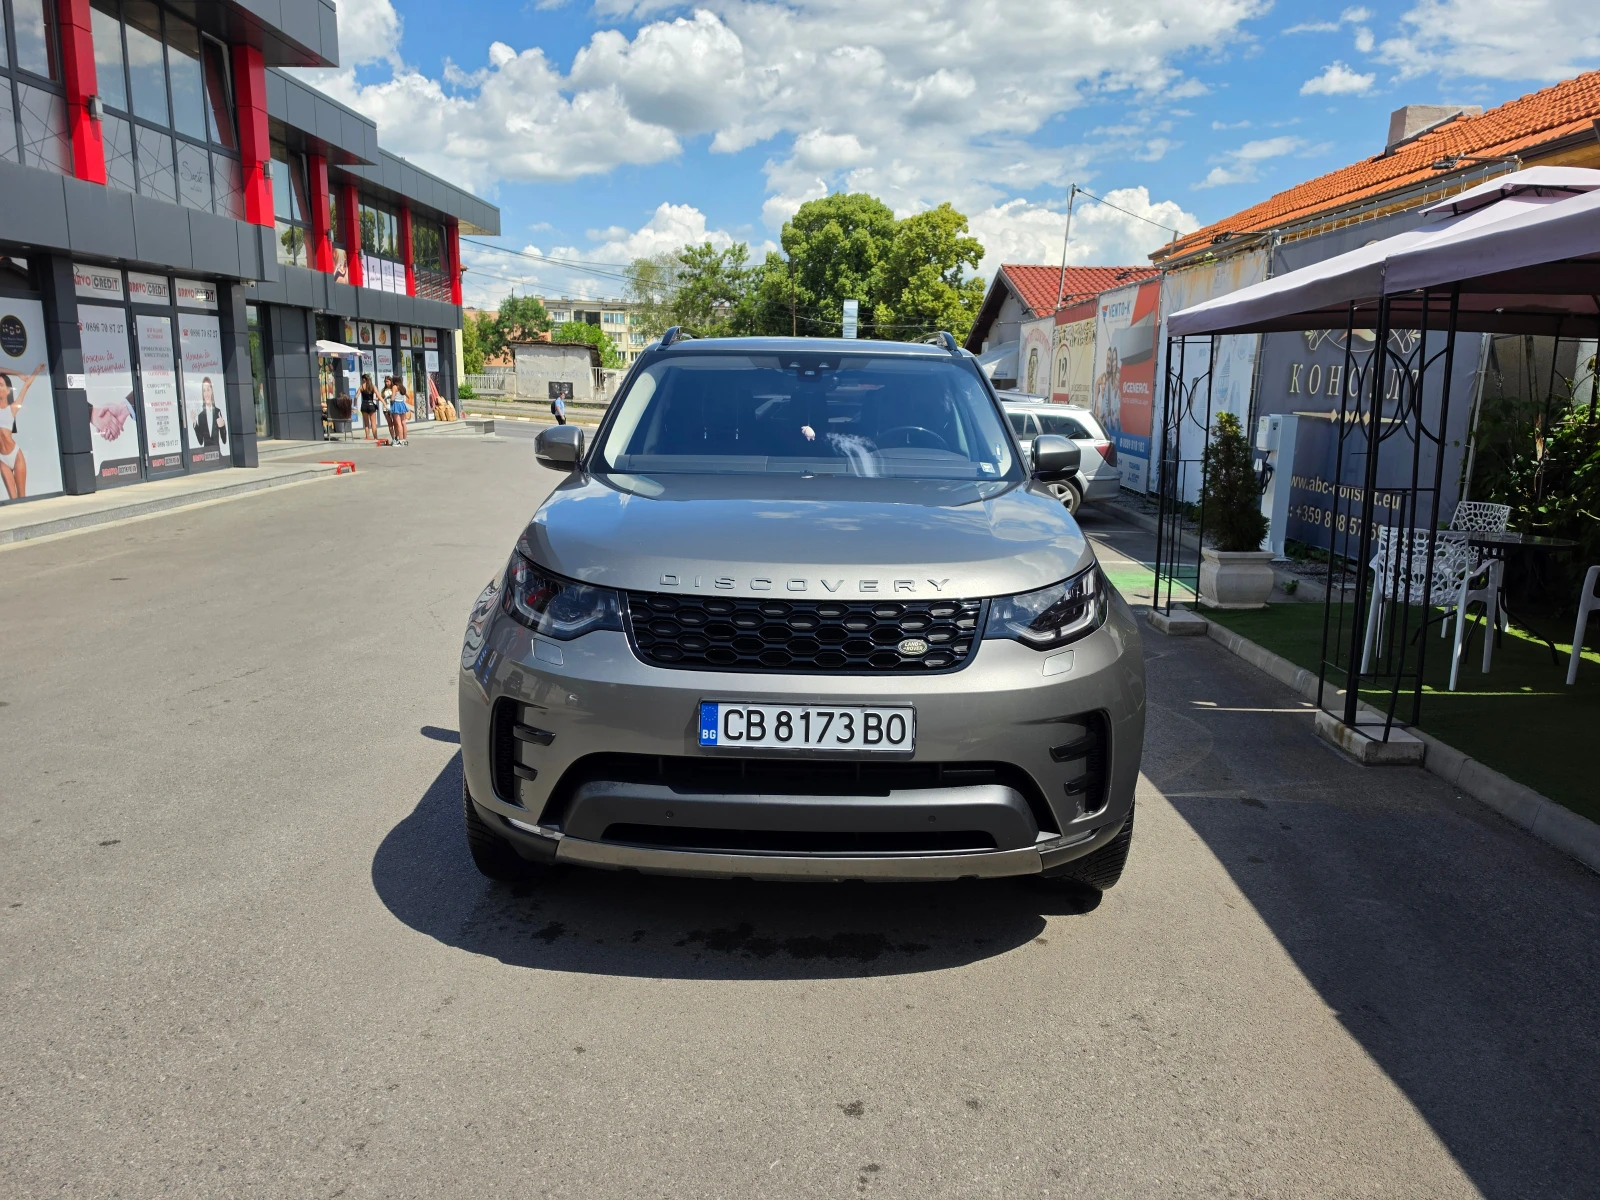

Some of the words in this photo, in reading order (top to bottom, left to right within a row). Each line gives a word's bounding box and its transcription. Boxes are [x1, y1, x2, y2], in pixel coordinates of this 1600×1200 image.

[94, 276, 118, 290] CREDIT
[148, 283, 166, 295] CREDIT
[86, 322, 100, 332] 0896
[101, 323, 108, 333] 70
[109, 324, 116, 334] 87
[118, 324, 124, 334] 27
[106, 350, 114, 360] да
[1057, 357, 1067, 387] 12
[1296, 505, 1321, 524] +359
[660, 574, 950, 592] DISCOVERY
[724, 709, 767, 741] CB
[774, 710, 855, 744] 8173
[863, 712, 907, 745] BO
[702, 730, 716, 740] BG
